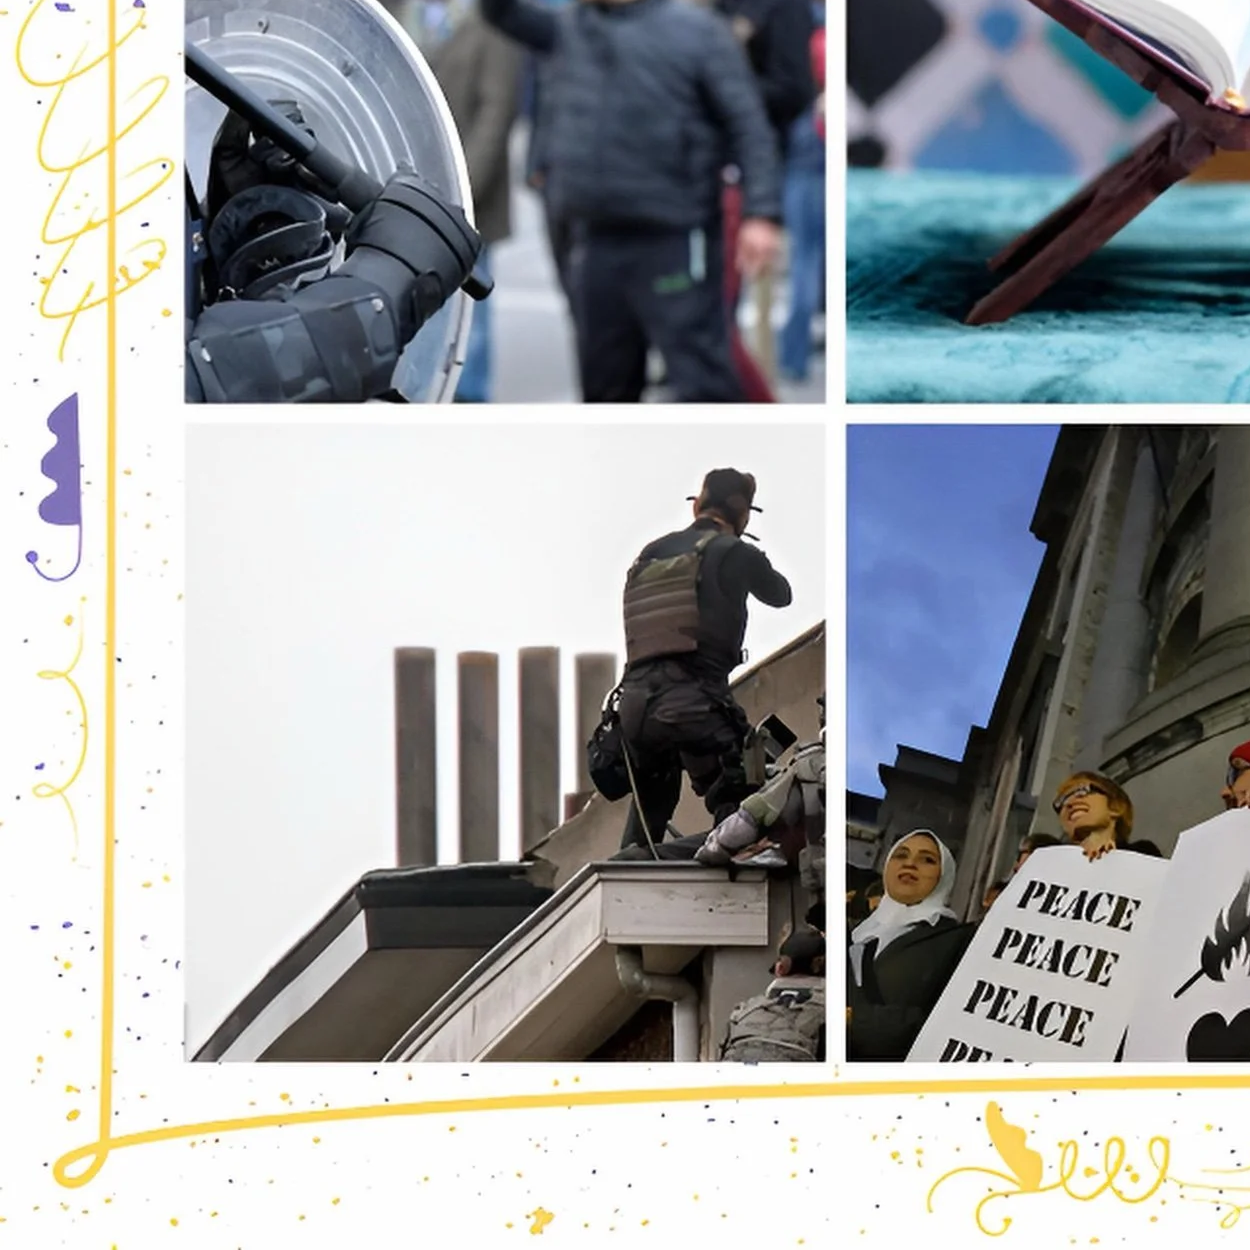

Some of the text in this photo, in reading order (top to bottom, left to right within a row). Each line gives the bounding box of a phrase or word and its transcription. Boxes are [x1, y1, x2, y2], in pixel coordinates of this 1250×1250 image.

[1016, 879, 1141, 933] PEACE
[991, 926, 1119, 988] PEACE
[963, 979, 1094, 1048] PEACE
